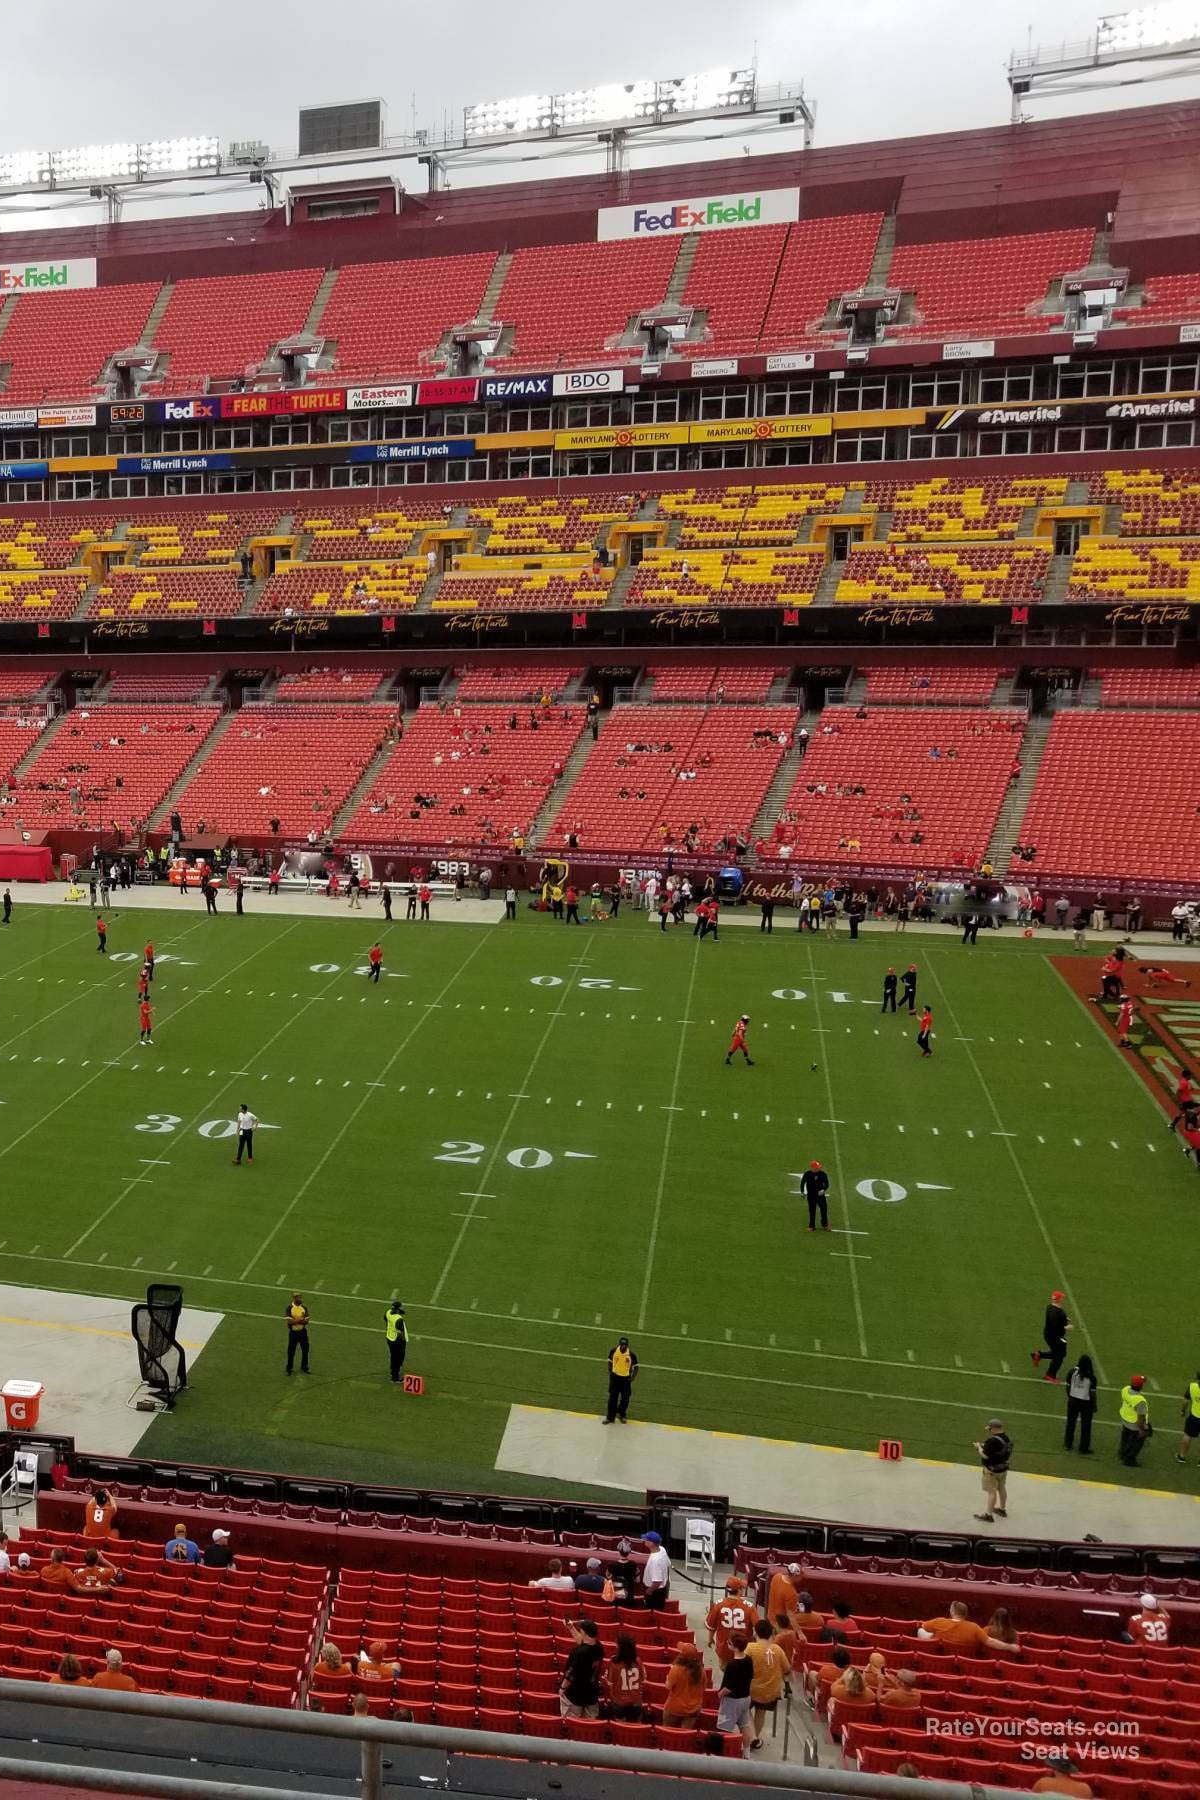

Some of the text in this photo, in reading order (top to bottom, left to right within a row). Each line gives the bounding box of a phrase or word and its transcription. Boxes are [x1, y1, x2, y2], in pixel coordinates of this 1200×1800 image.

[633, 197, 761, 233] FedExField
[486, 379, 548, 397] RE/MAX
[571, 373, 610, 389] BDO
[361, 388, 408, 400] Eastern
[165, 401, 213, 420] FedEx
[991, 406, 1062, 424] Ameritel
[1120, 398, 1195, 417] Ameritel
[570, 433, 670, 445] MARYLAND LOTTERY
[707, 424, 813, 437] MARYLAND LOTTERY
[389, 444, 449, 457] Merrill Lynch
[152, 458, 207, 470] Merrill Lynch
[752, 886, 767, 897] to
[769, 882, 793, 898] the
[134, 1113, 238, 1138] 30
[433, 1141, 553, 1168] 20
[788, 1173, 907, 1202] 0
[405, 1376, 421, 1393] 20
[10, 1402, 26, 1420] G
[882, 1442, 900, 1460] 10
[93, 1509, 104, 1523] 8
[720, 1607, 746, 1629] 32
[1141, 1620, 1168, 1641] 32
[620, 1667, 640, 1691] 12
